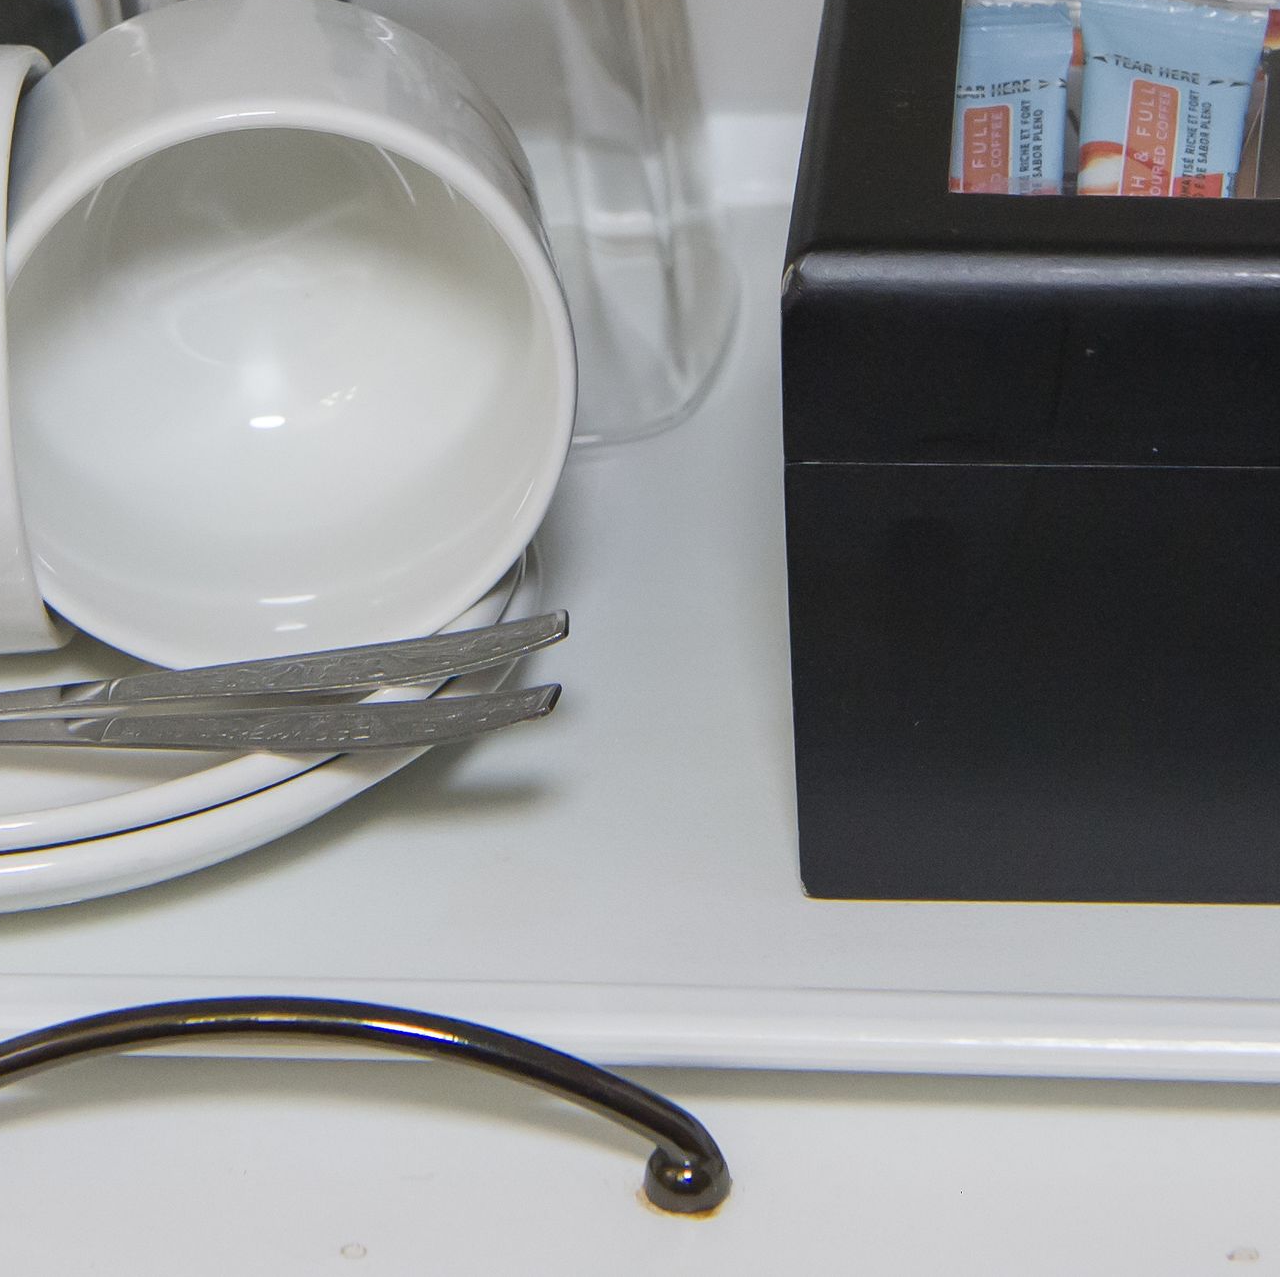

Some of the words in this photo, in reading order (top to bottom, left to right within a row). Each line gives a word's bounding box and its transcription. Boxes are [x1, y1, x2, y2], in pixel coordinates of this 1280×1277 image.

[1114, 53, 1153, 75] TEAR
[1159, 67, 1200, 85] HERE
[991, 79, 1031, 97] HERE
[1188, 89, 1200, 112] FORT
[1020, 100, 1031, 125] FORT
[1032, 108, 1044, 141] PLENO
[1136, 86, 1157, 137] FULL
[1156, 92, 1172, 141] COFFEE
[1187, 113, 1199, 125] ET
[1200, 101, 1212, 130] PLENO
[972, 112, 988, 169] FULL
[991, 112, 1003, 168] COFFEE
[1020, 129, 1031, 141] ET
[1185, 125, 1198, 156] RICHE
[1197, 131, 1210, 163] SABOR
[1019, 143, 1030, 172] RICHE
[1032, 144, 1043, 179] SABOR
[1133, 151, 1150, 162] &
